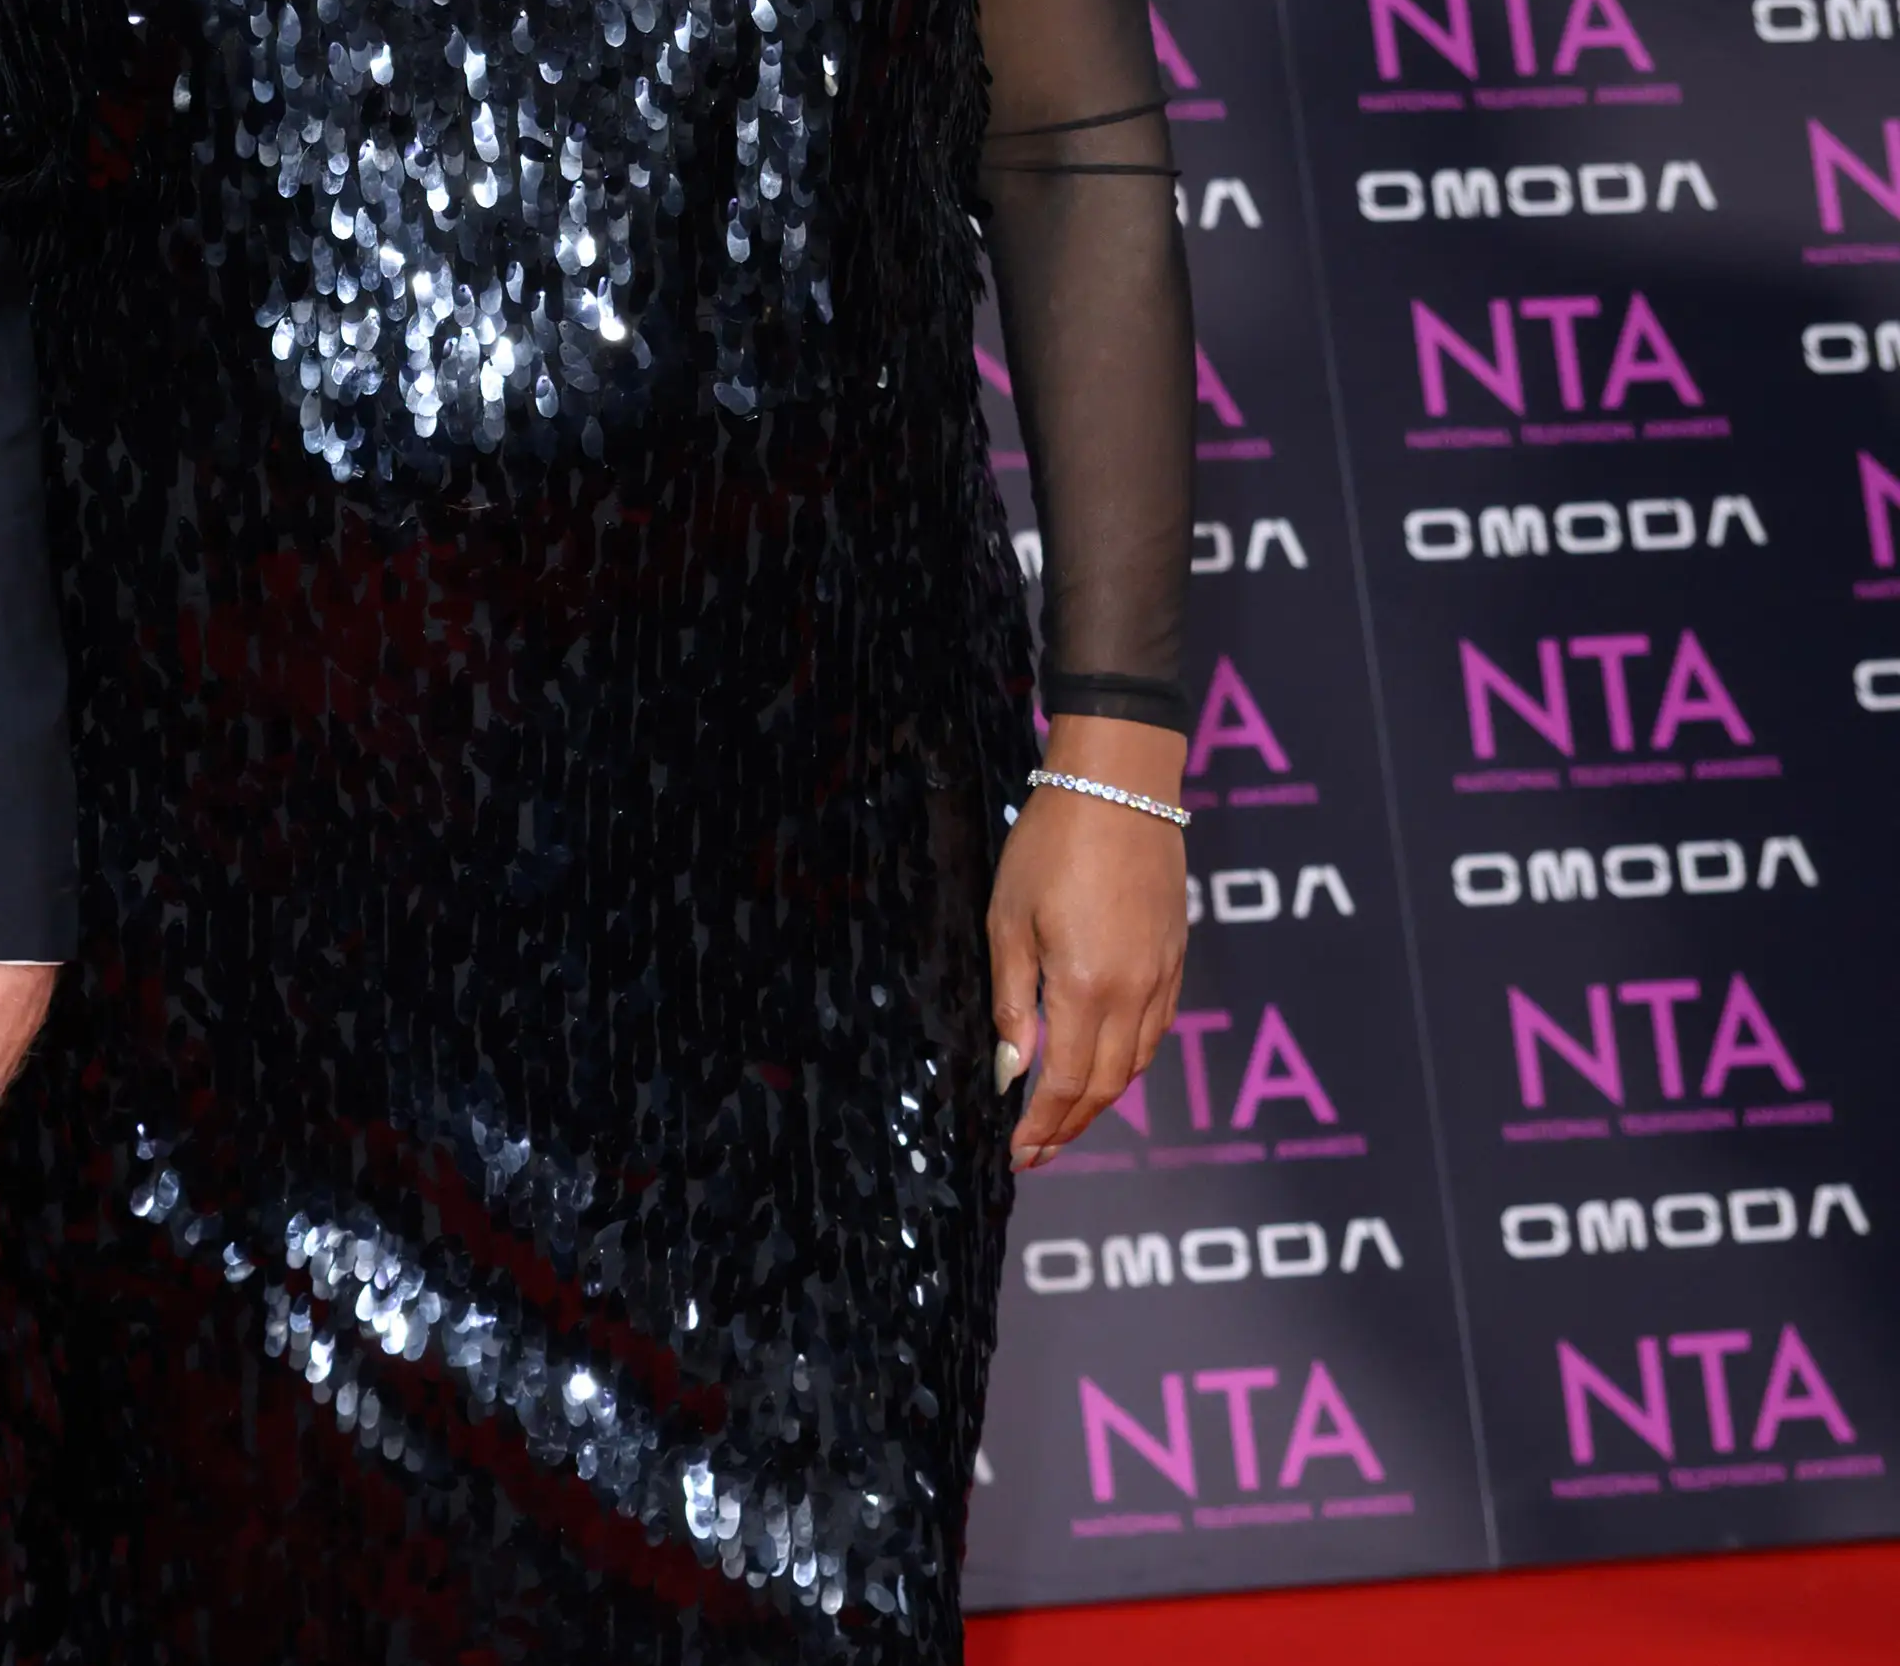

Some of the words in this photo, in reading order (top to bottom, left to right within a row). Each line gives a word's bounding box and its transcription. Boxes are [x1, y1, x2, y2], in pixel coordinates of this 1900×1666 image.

[1355, 160, 1719, 222] OMODA
[1409, 290, 1705, 417] NTA
[1402, 495, 1768, 562] OMODA
[1458, 628, 1756, 761] NTA
[1450, 836, 1819, 908] OMODA
[1505, 971, 1807, 1109] NTA
[1022, 1217, 1404, 1295] OMODA
[1499, 1183, 1871, 1260] OMODA
[1078, 1359, 1388, 1504] NTA
[1555, 1322, 1858, 1467] NTA
